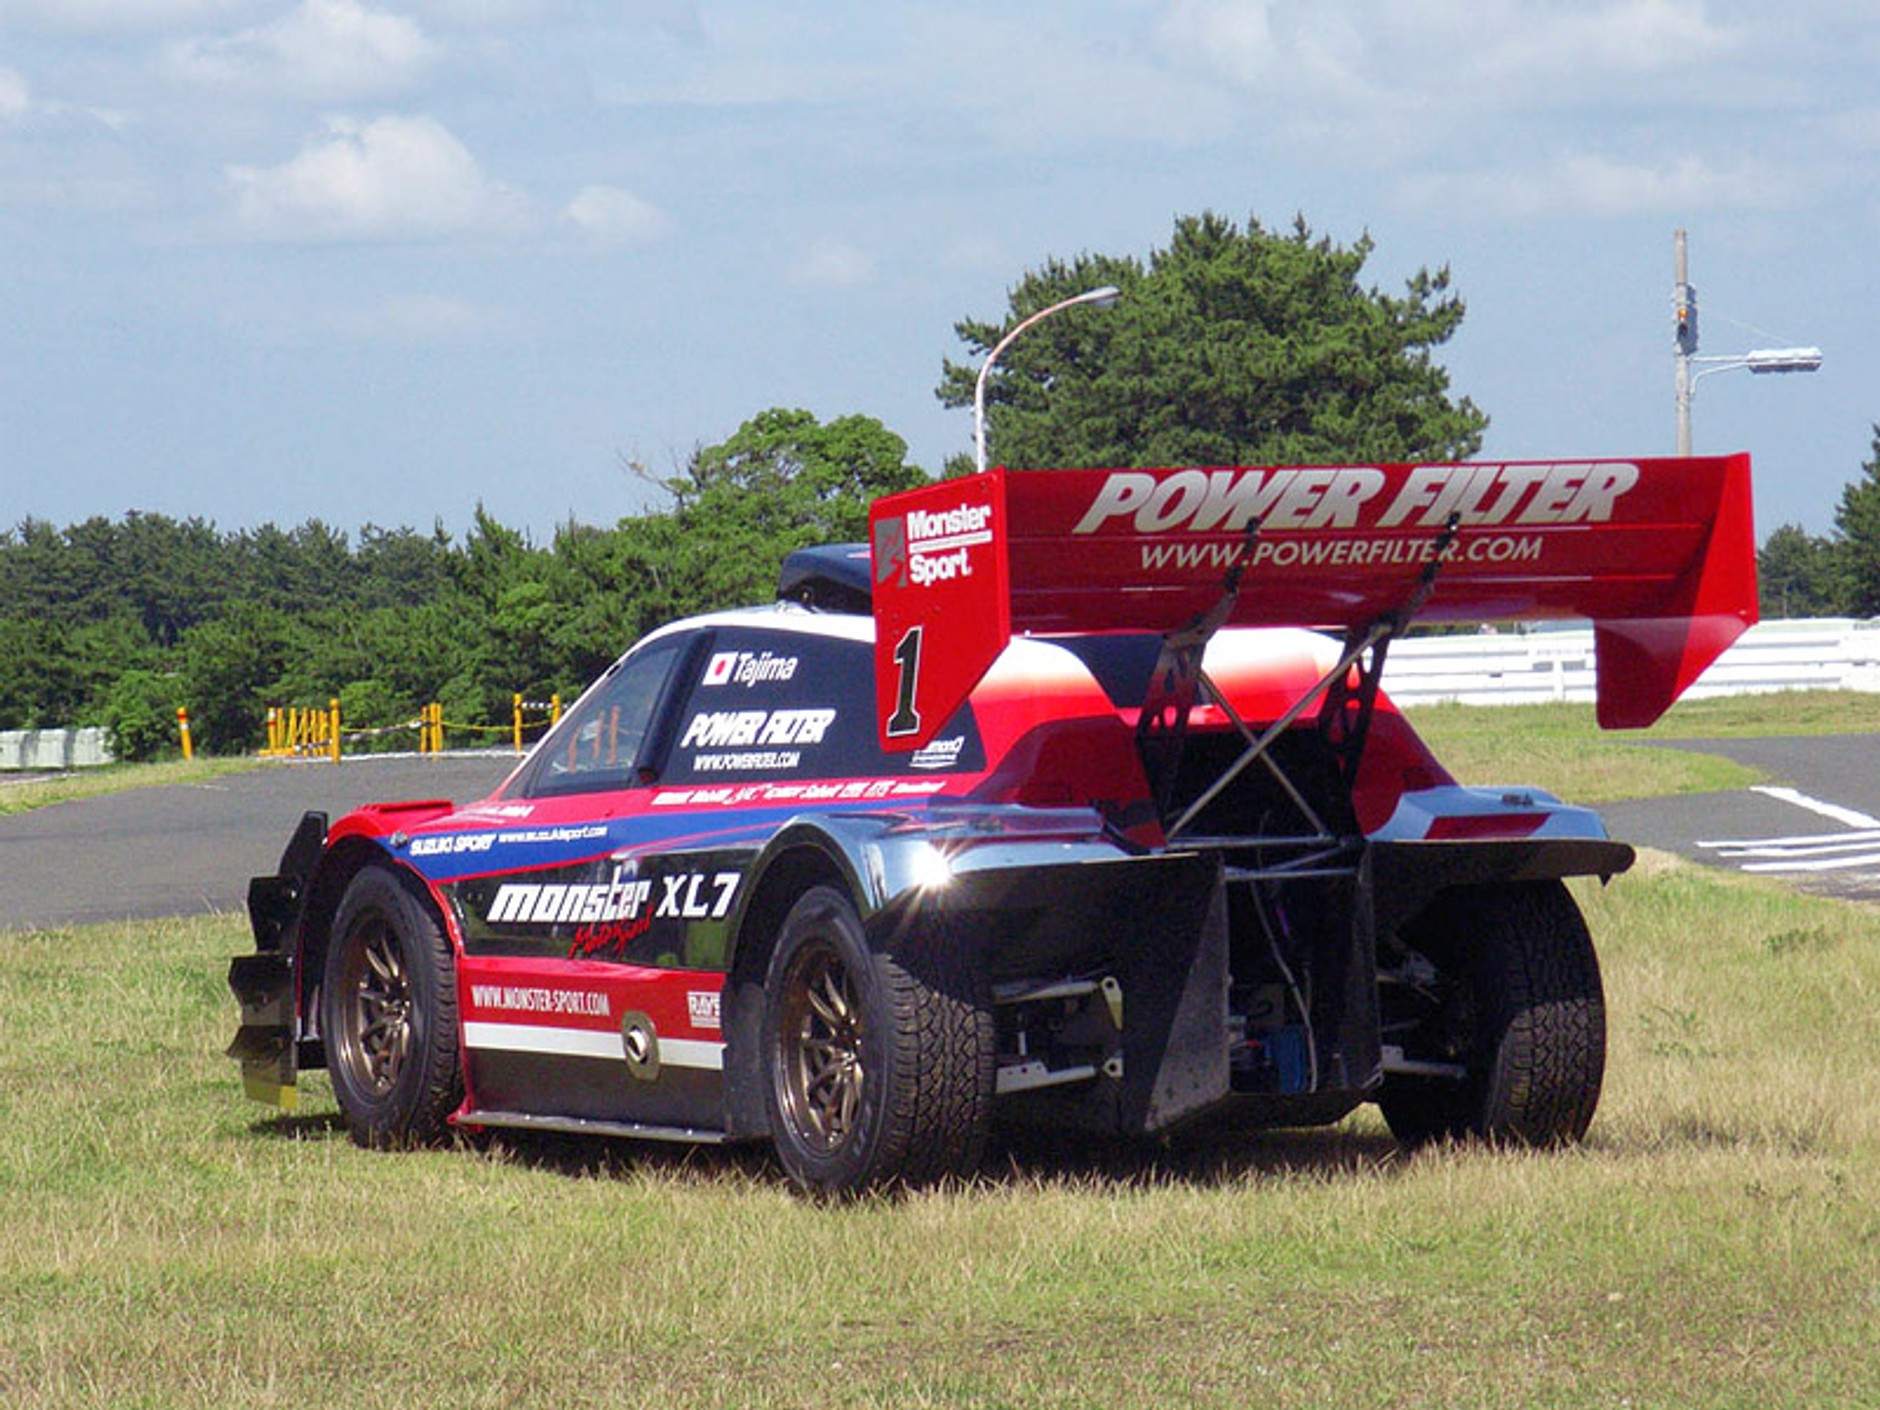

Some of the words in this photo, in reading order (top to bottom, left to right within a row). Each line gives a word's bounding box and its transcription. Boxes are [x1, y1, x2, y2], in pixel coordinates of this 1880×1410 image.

[1073, 468, 1386, 534] POWER
[1374, 462, 1640, 528] FILTER
[907, 503, 992, 541] Monster
[1140, 536, 1543, 570] WWW.POWERFILTER.COM
[733, 651, 798, 687] Tajima
[886, 625, 923, 737] 1
[680, 711, 768, 748] POWER
[486, 865, 652, 922] monster
[656, 872, 741, 918] XL7
